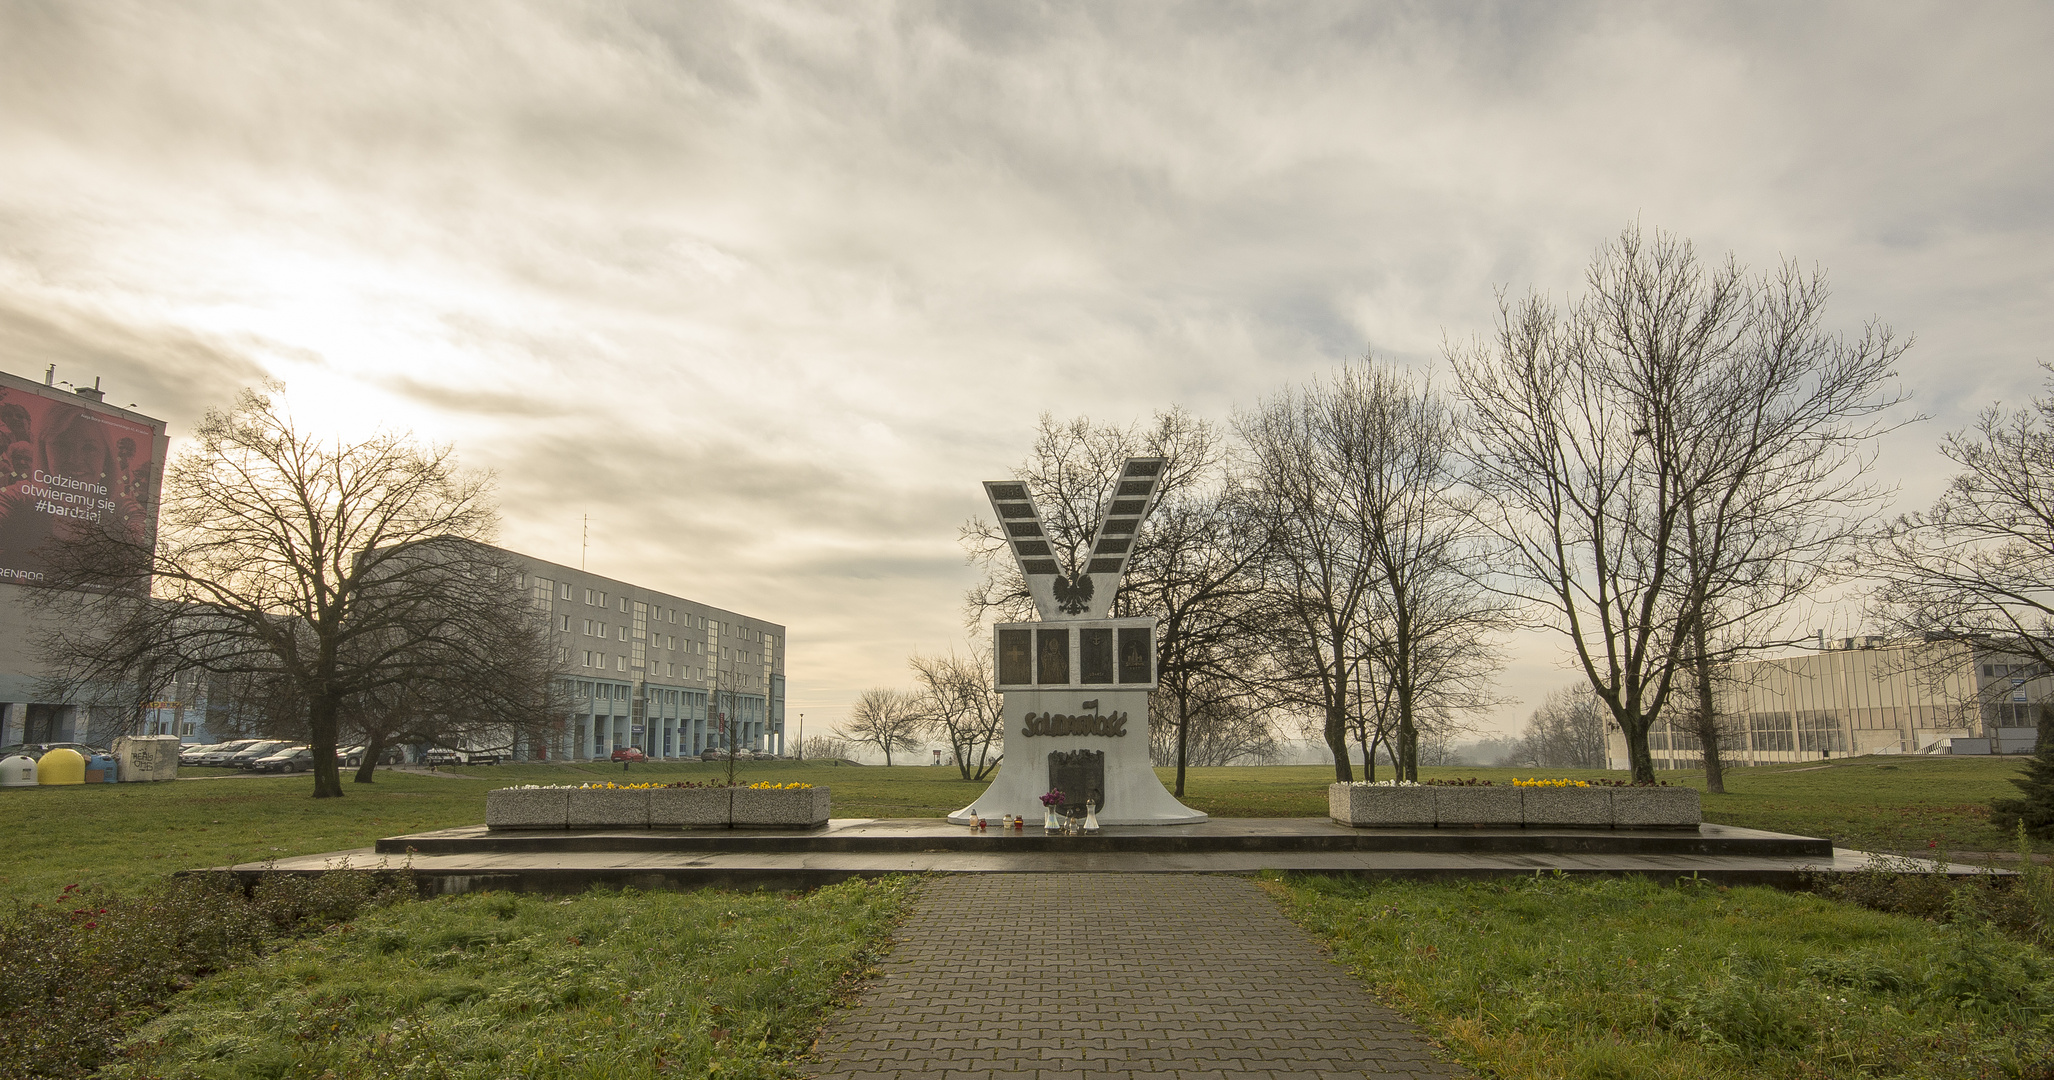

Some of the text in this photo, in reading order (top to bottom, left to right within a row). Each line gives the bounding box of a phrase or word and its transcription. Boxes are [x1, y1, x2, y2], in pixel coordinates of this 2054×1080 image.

[34, 469, 108, 496] Codziennie
[21, 484, 116, 513] otwieramy się
[34, 500, 101, 525] #bardziej
[1020, 542, 1046, 552] 1979
